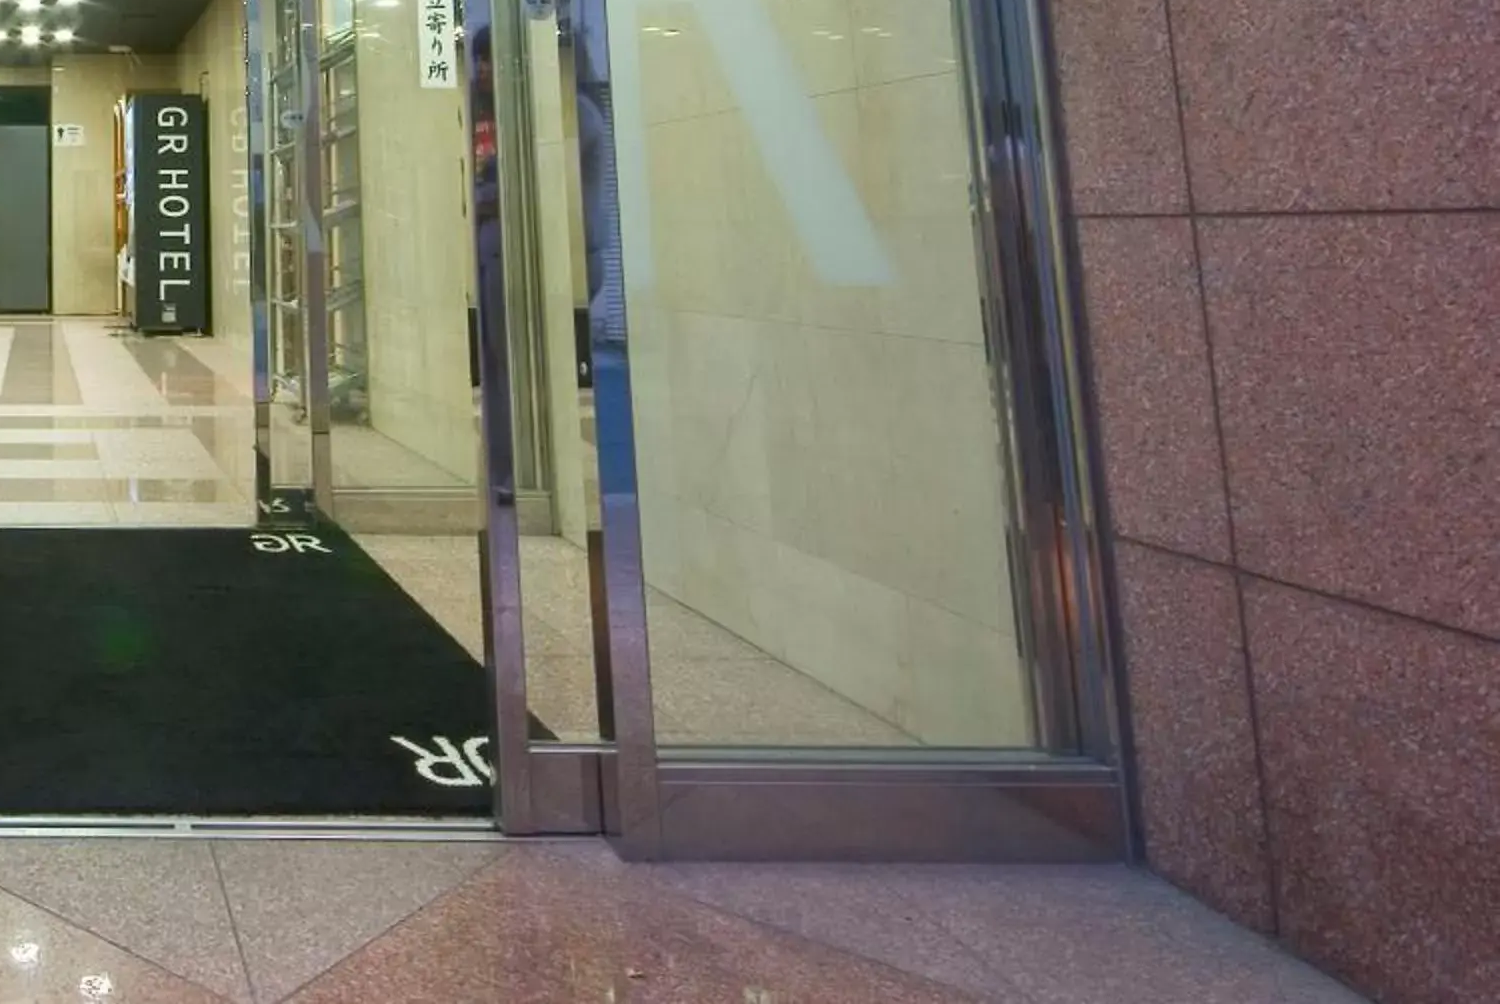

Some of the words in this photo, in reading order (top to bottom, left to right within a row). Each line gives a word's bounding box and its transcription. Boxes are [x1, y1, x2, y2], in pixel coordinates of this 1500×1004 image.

[156, 106, 189, 155] GR
[158, 169, 191, 301] HOTEL
[249, 533, 333, 553] GR
